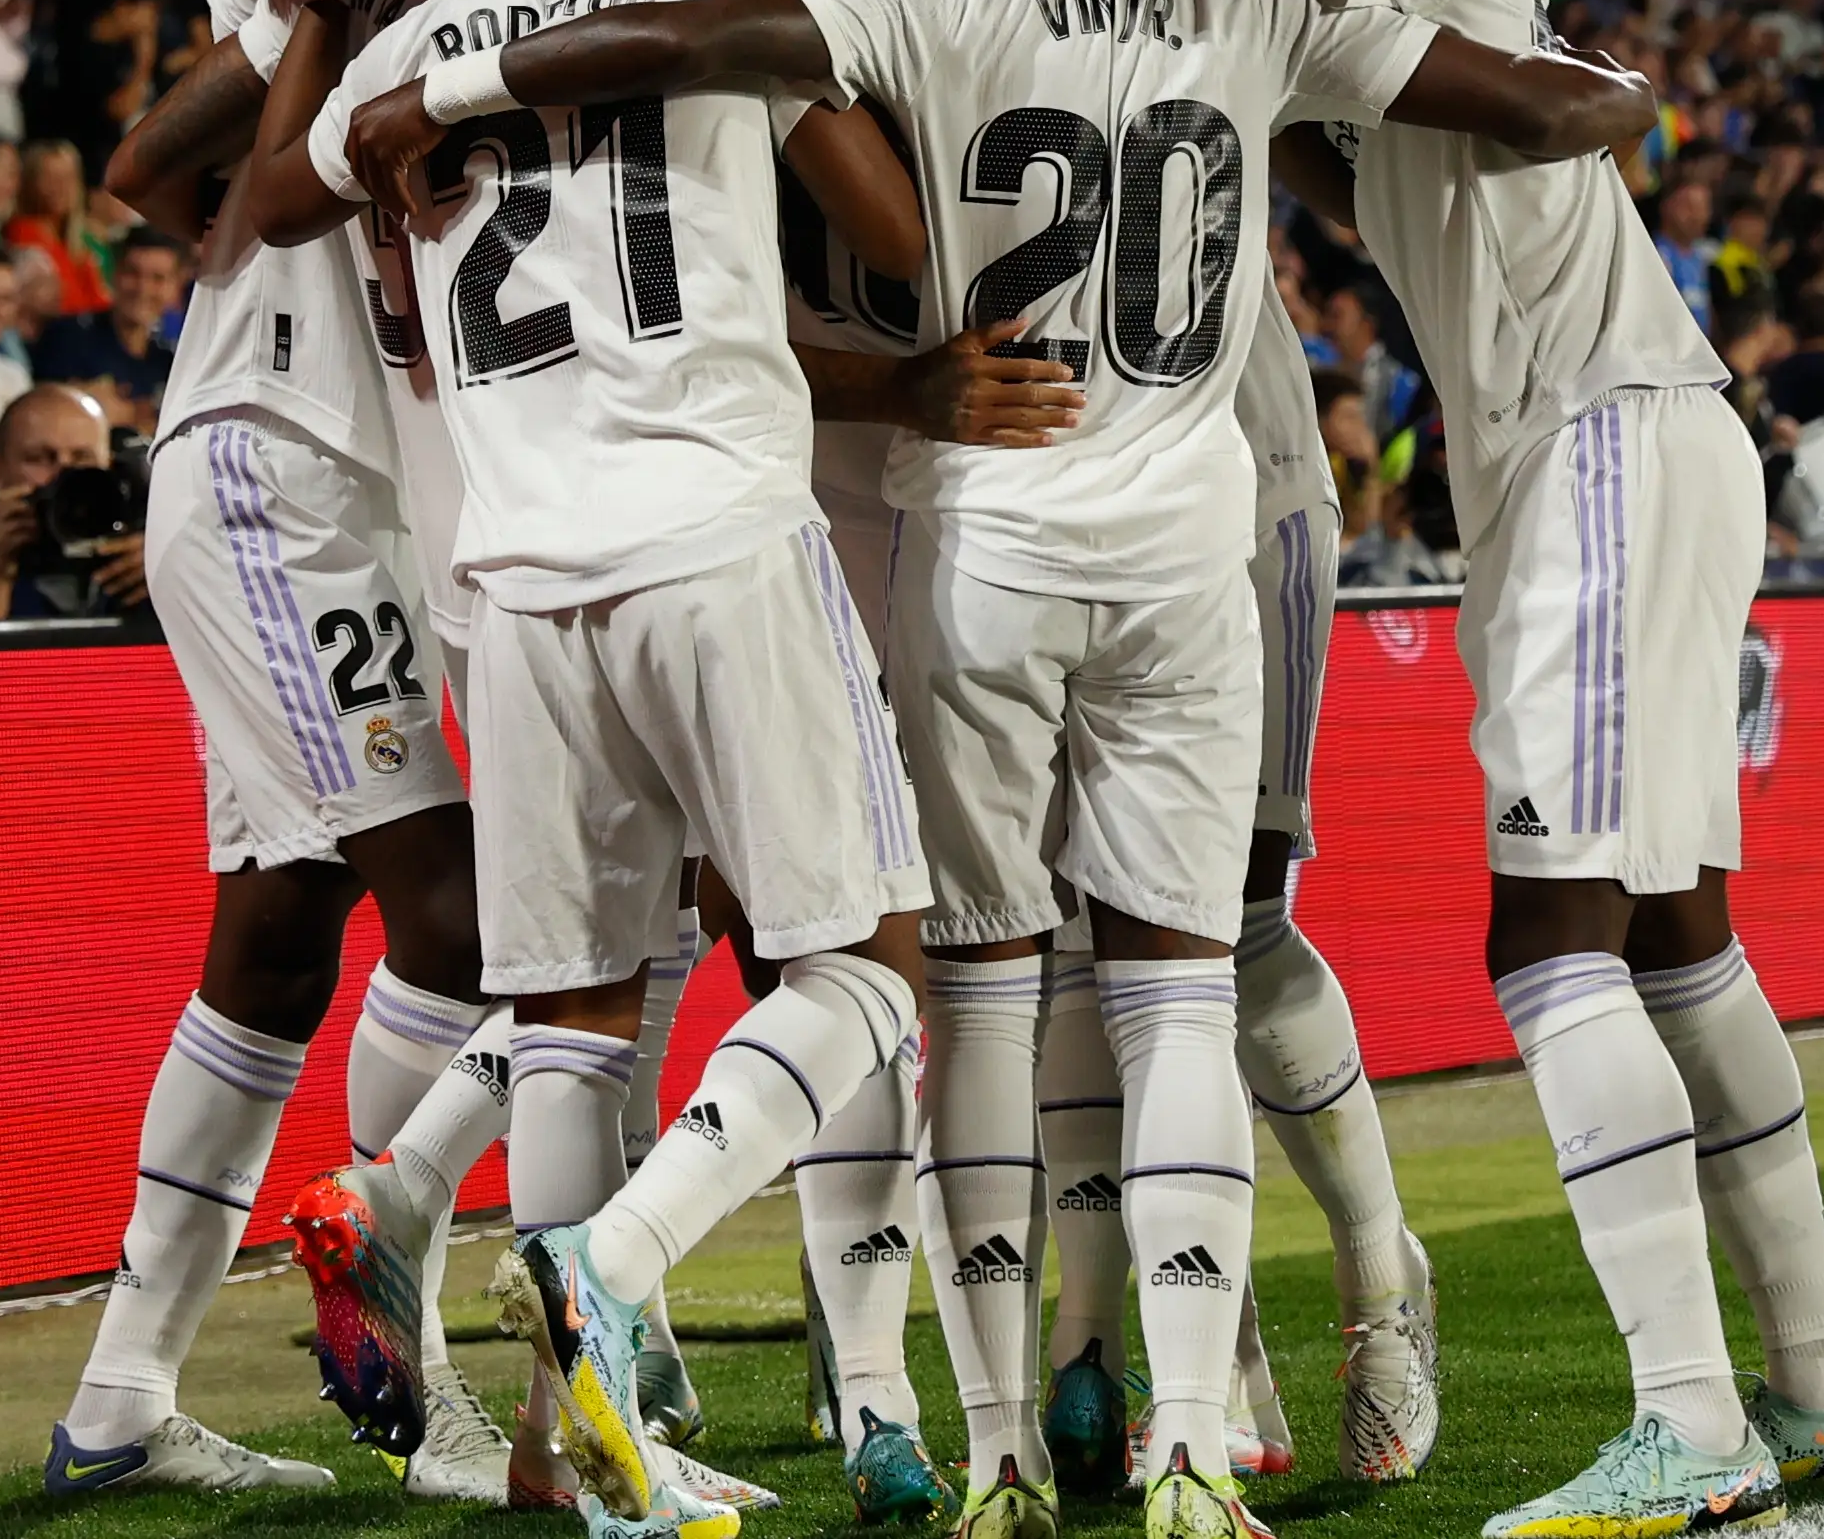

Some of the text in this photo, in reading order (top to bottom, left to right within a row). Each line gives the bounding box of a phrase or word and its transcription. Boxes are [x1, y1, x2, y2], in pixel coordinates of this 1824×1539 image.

[426, 93, 683, 390] 21
[960, 99, 1243, 389] 20
[312, 601, 426, 717] 22
[1496, 818, 1549, 838] adidas
[451, 1056, 509, 1107] adidas
[674, 1117, 729, 1151] didas
[1056, 1195, 1121, 1212] adida
[841, 1246, 912, 1267] adidas
[952, 1260, 1033, 1287] adidas
[1151, 1268, 1232, 1293] adidas
